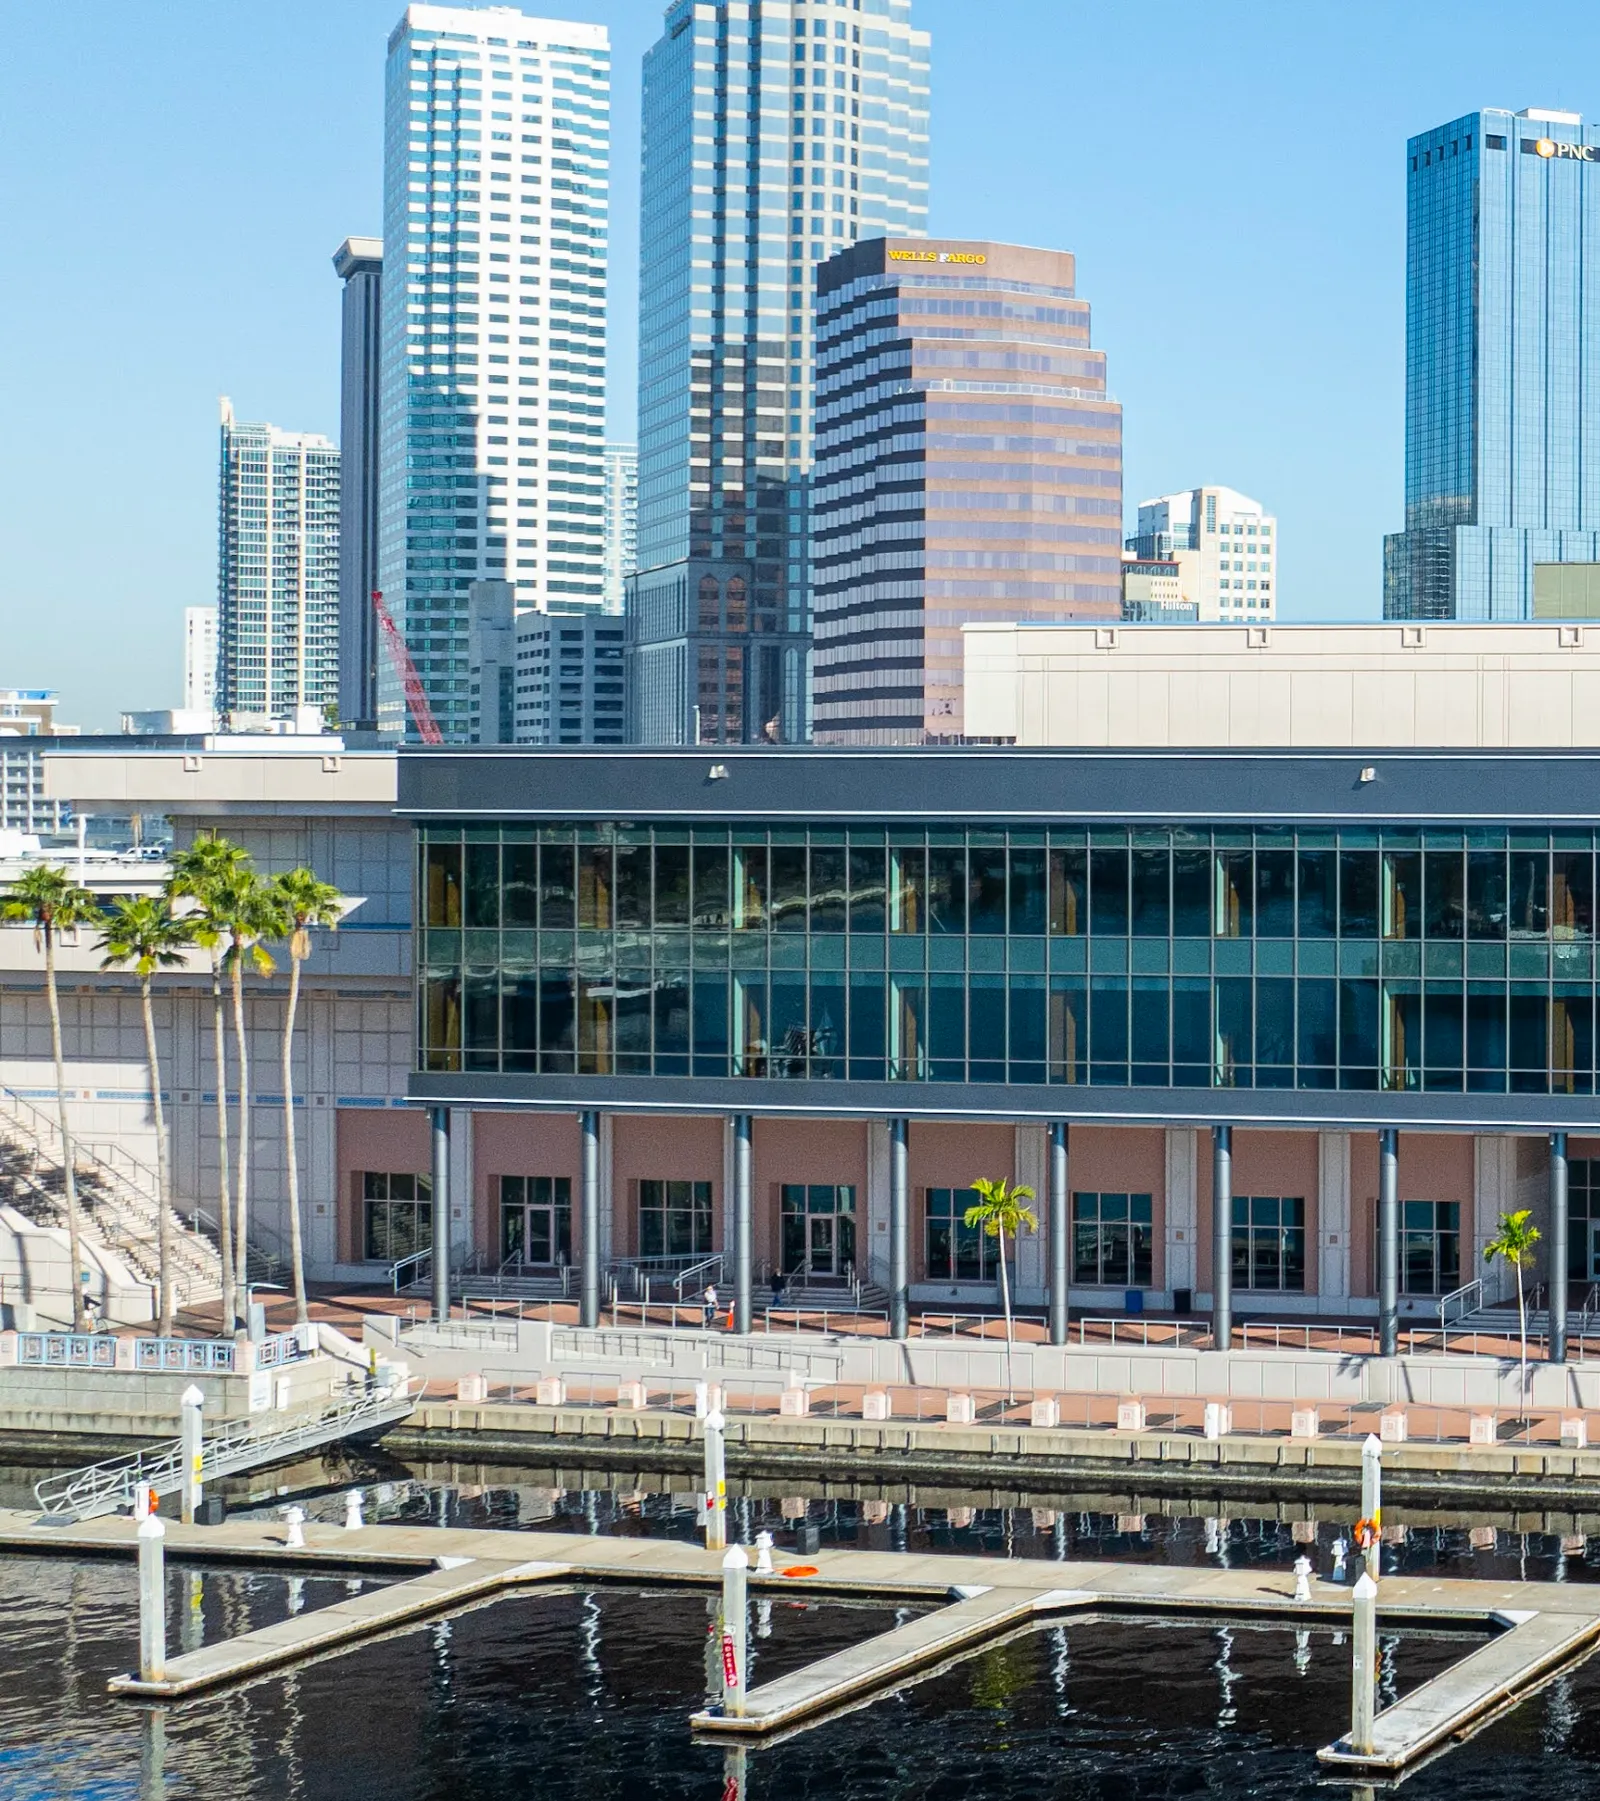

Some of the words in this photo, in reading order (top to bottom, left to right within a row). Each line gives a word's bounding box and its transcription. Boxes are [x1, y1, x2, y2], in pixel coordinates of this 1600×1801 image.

[1557, 143, 1594, 161] PNC
[888, 250, 936, 262] WELLS
[939, 252, 986, 265] FARGO
[1160, 601, 1193, 611] Hilton
